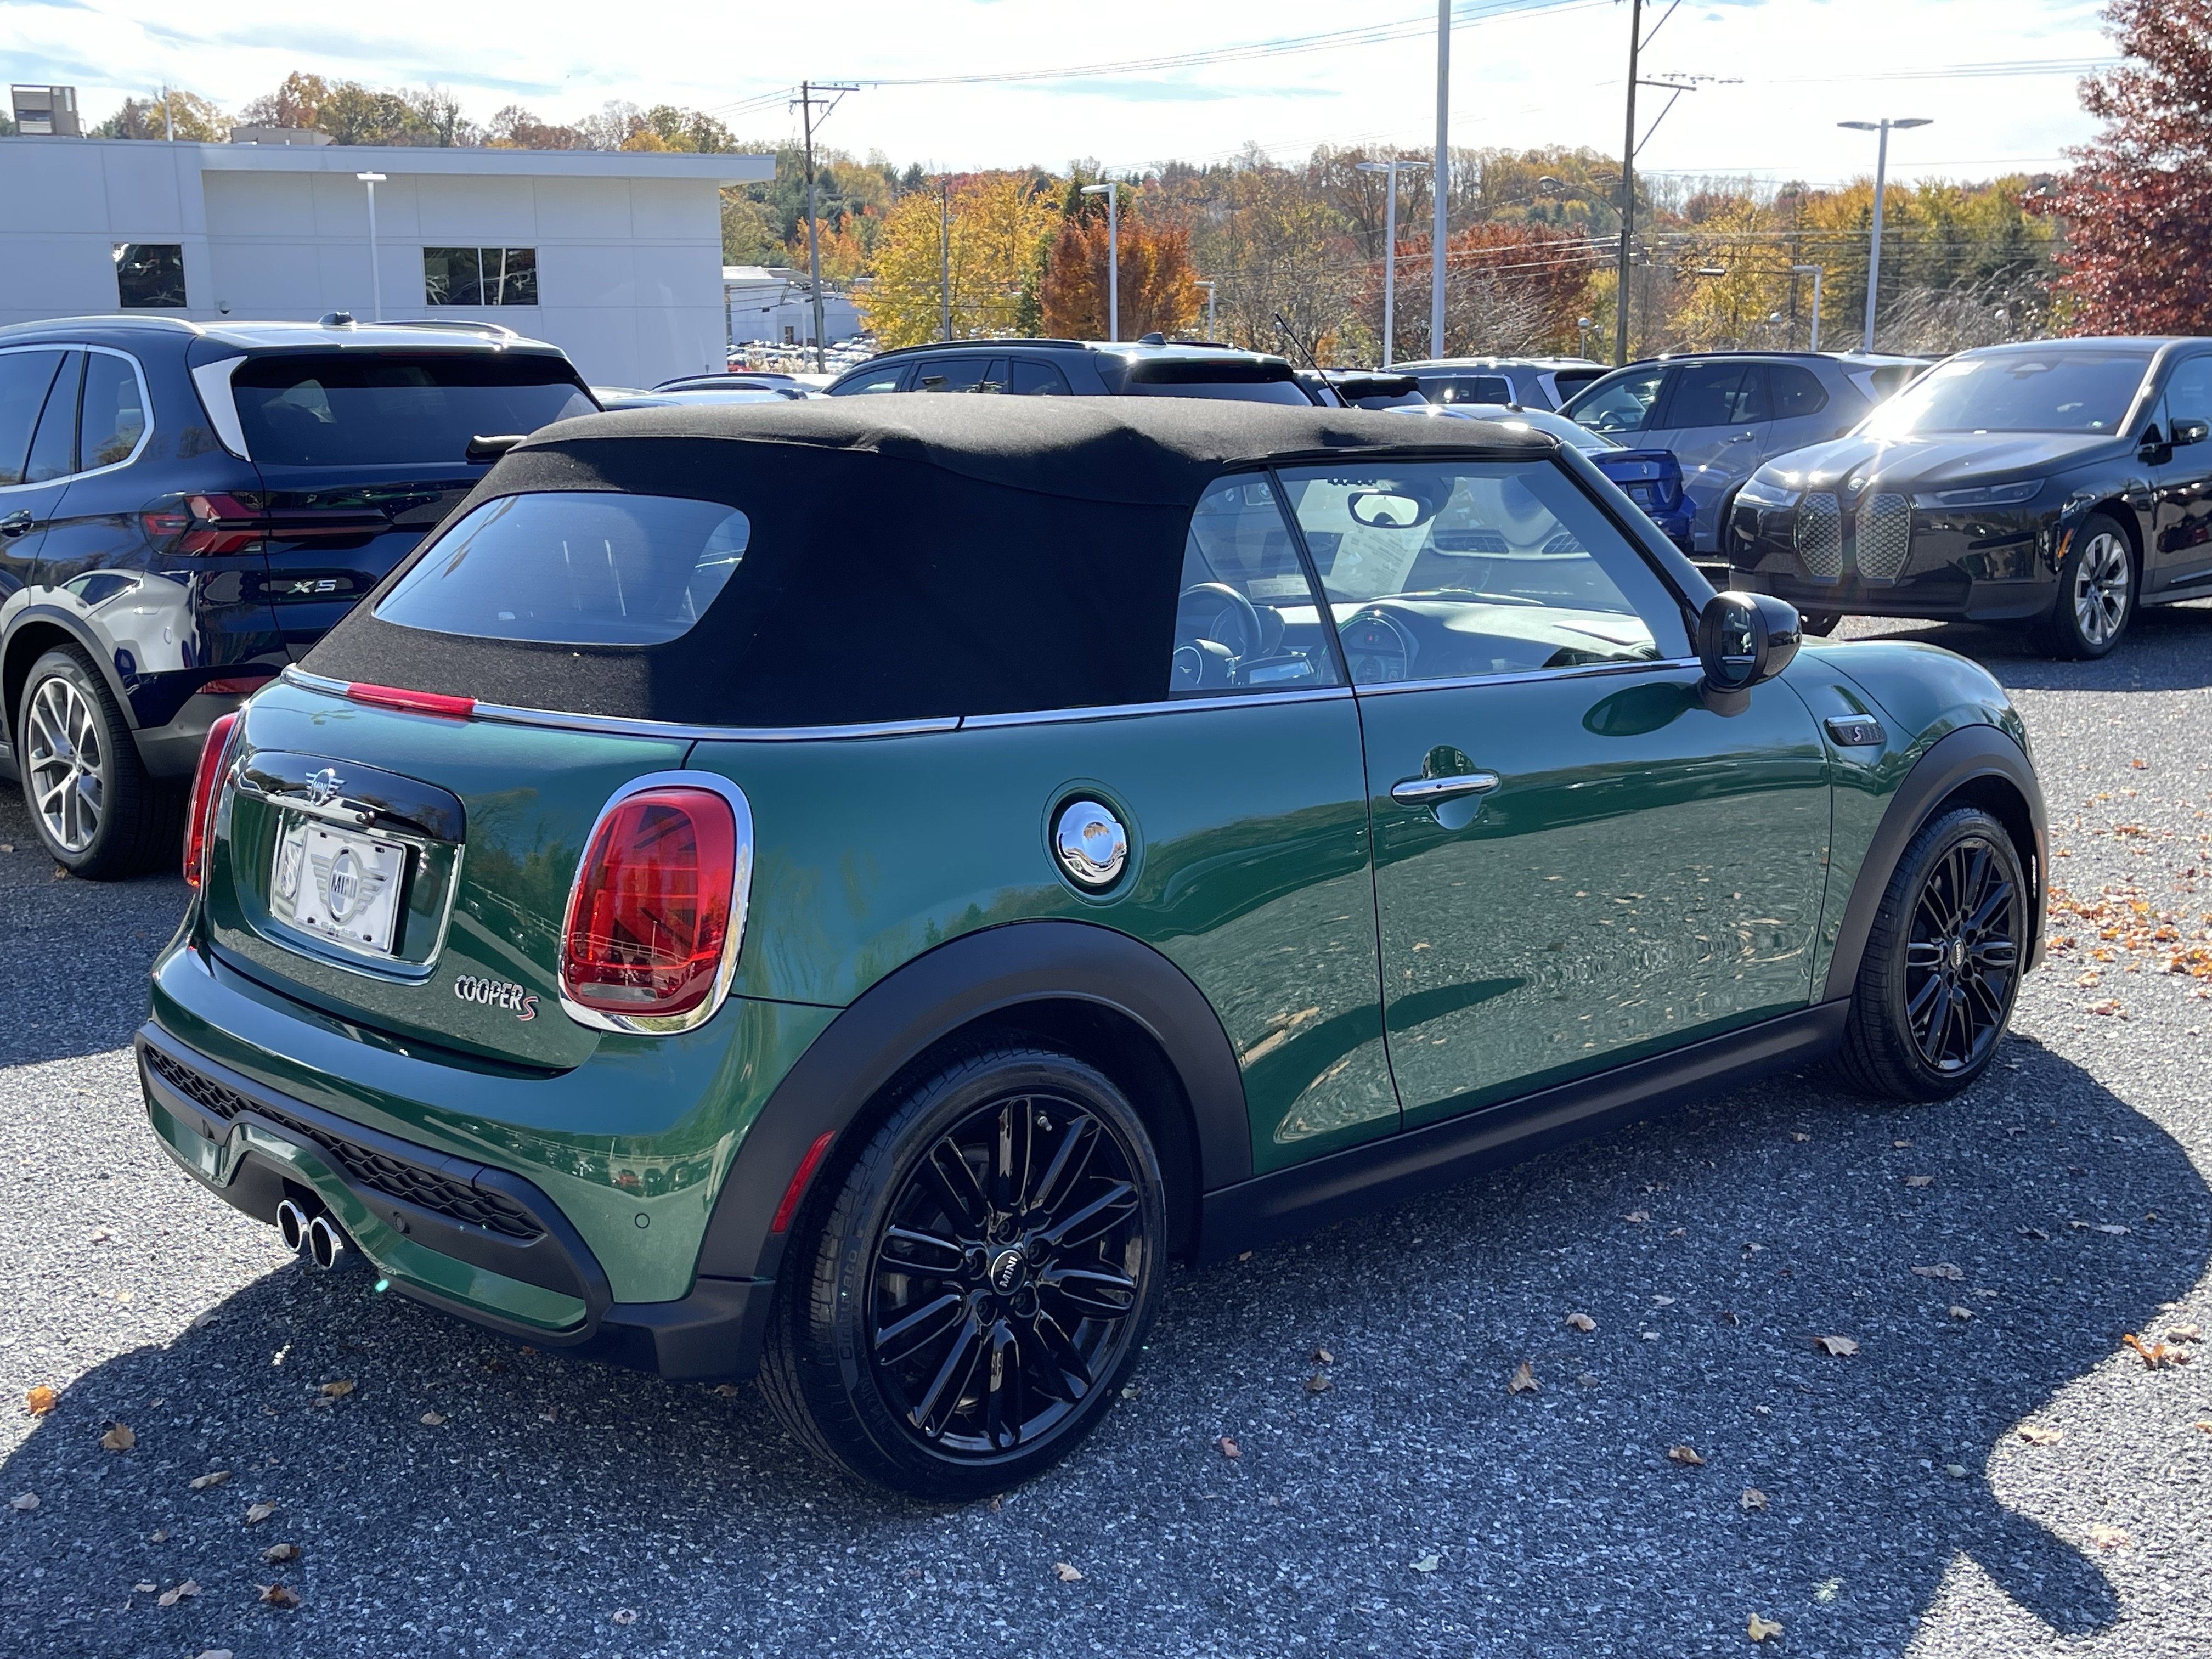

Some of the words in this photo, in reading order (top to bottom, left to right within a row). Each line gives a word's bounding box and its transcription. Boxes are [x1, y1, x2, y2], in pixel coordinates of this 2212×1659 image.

[286, 579, 337, 594] X5
[331, 871, 358, 899] MINI
[454, 975, 524, 1011] COOPER
[516, 996, 539, 1022] S
[999, 1256, 1018, 1288] MINI
